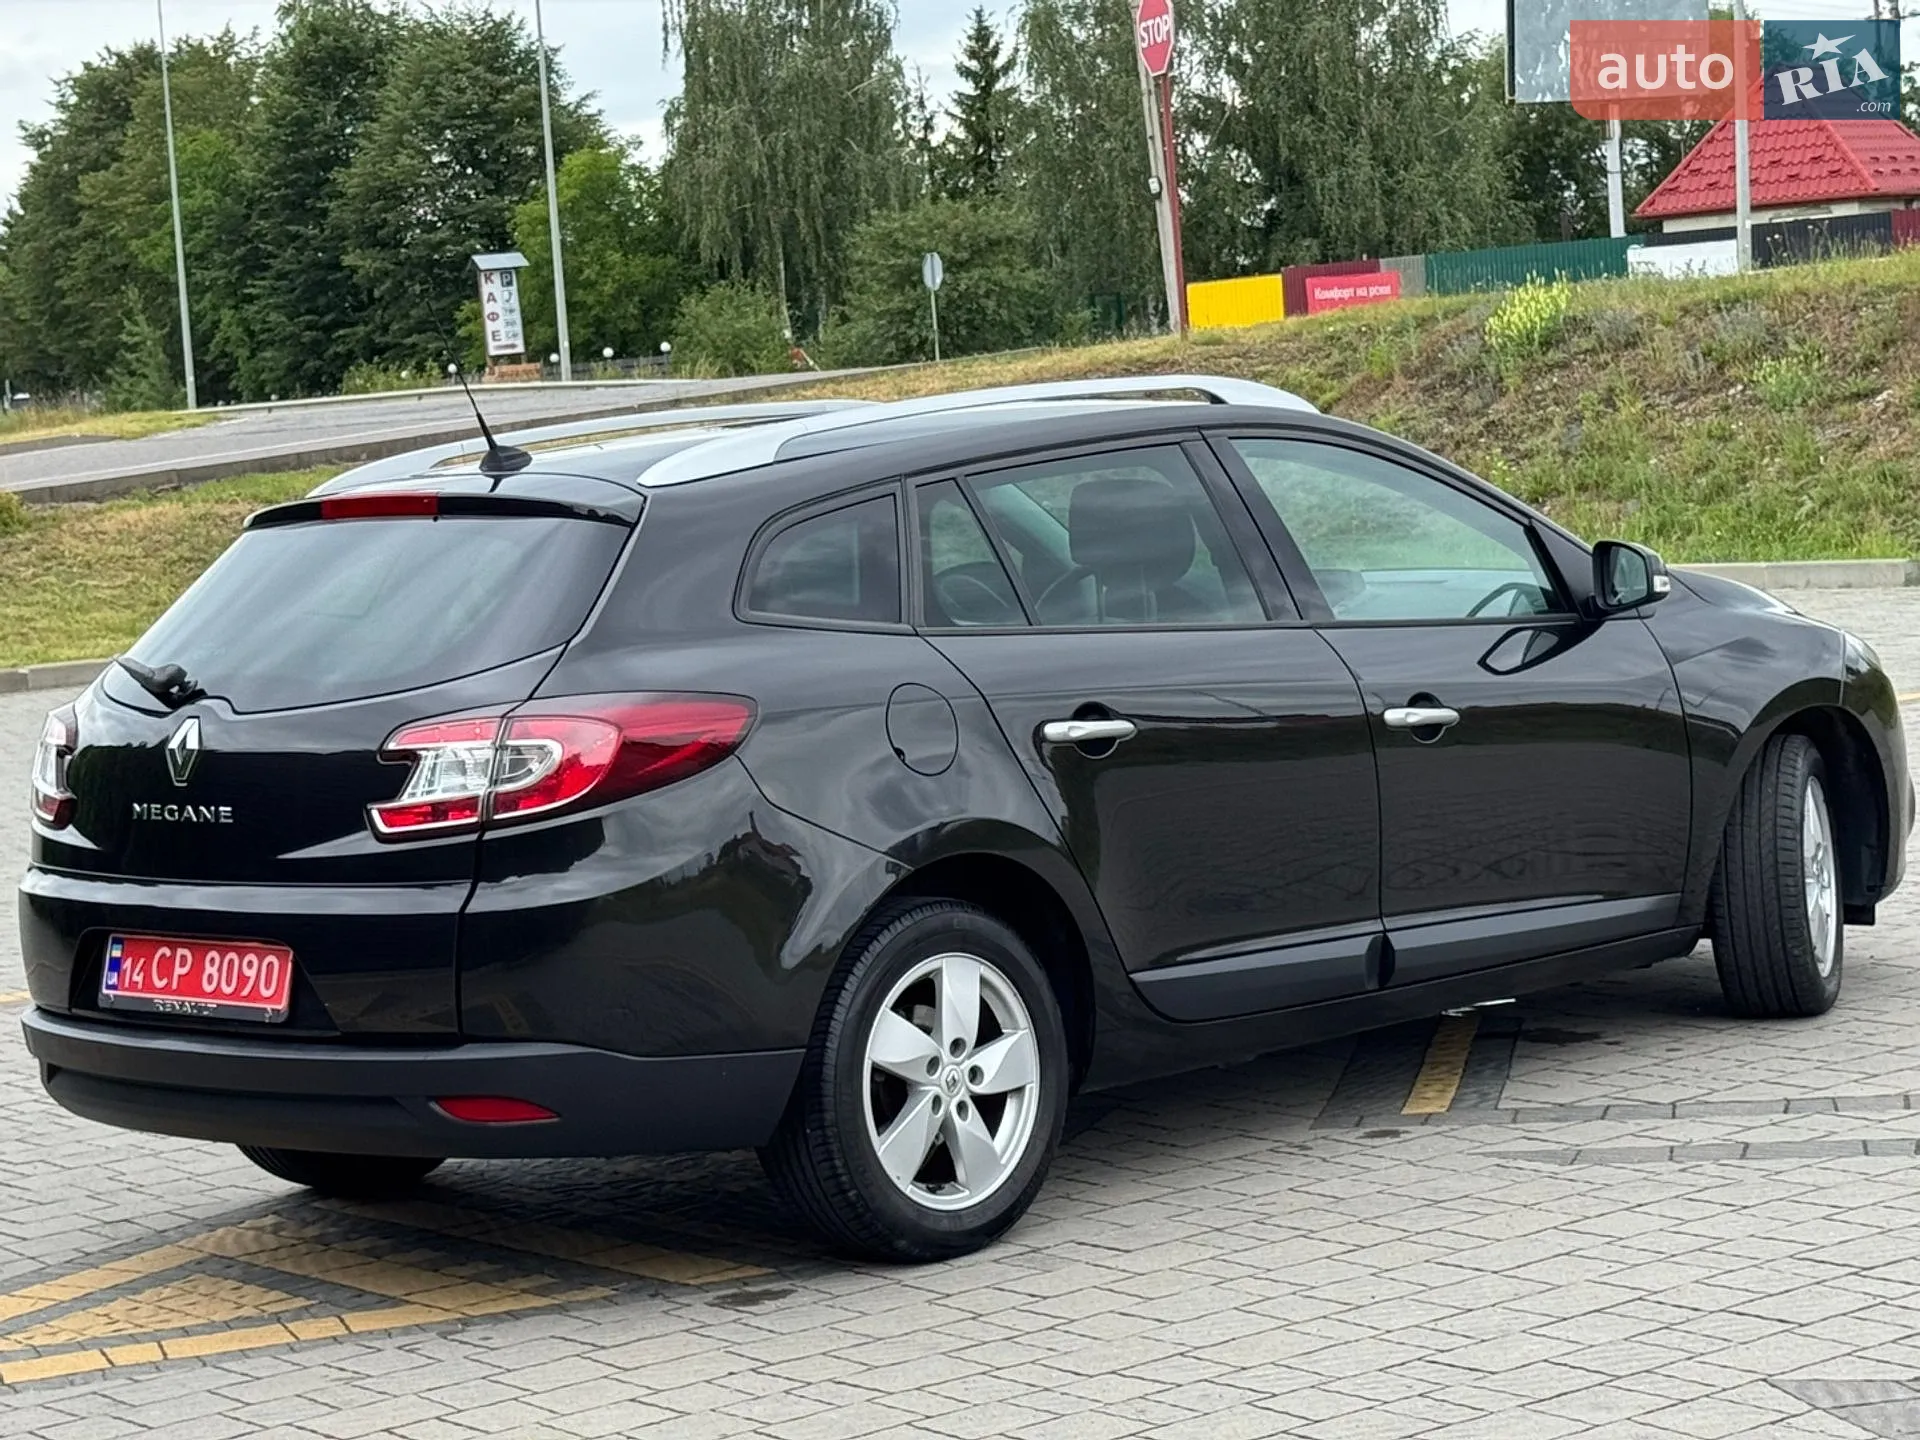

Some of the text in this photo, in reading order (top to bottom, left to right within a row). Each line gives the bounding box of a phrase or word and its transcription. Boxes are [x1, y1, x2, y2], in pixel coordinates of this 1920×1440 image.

[1140, 14, 1170, 48] STOP
[1314, 286, 1355, 301] Комфорт
[1356, 286, 1368, 297] на
[132, 803, 234, 823] MEGANE
[122, 946, 280, 998] 14 CP 8090
